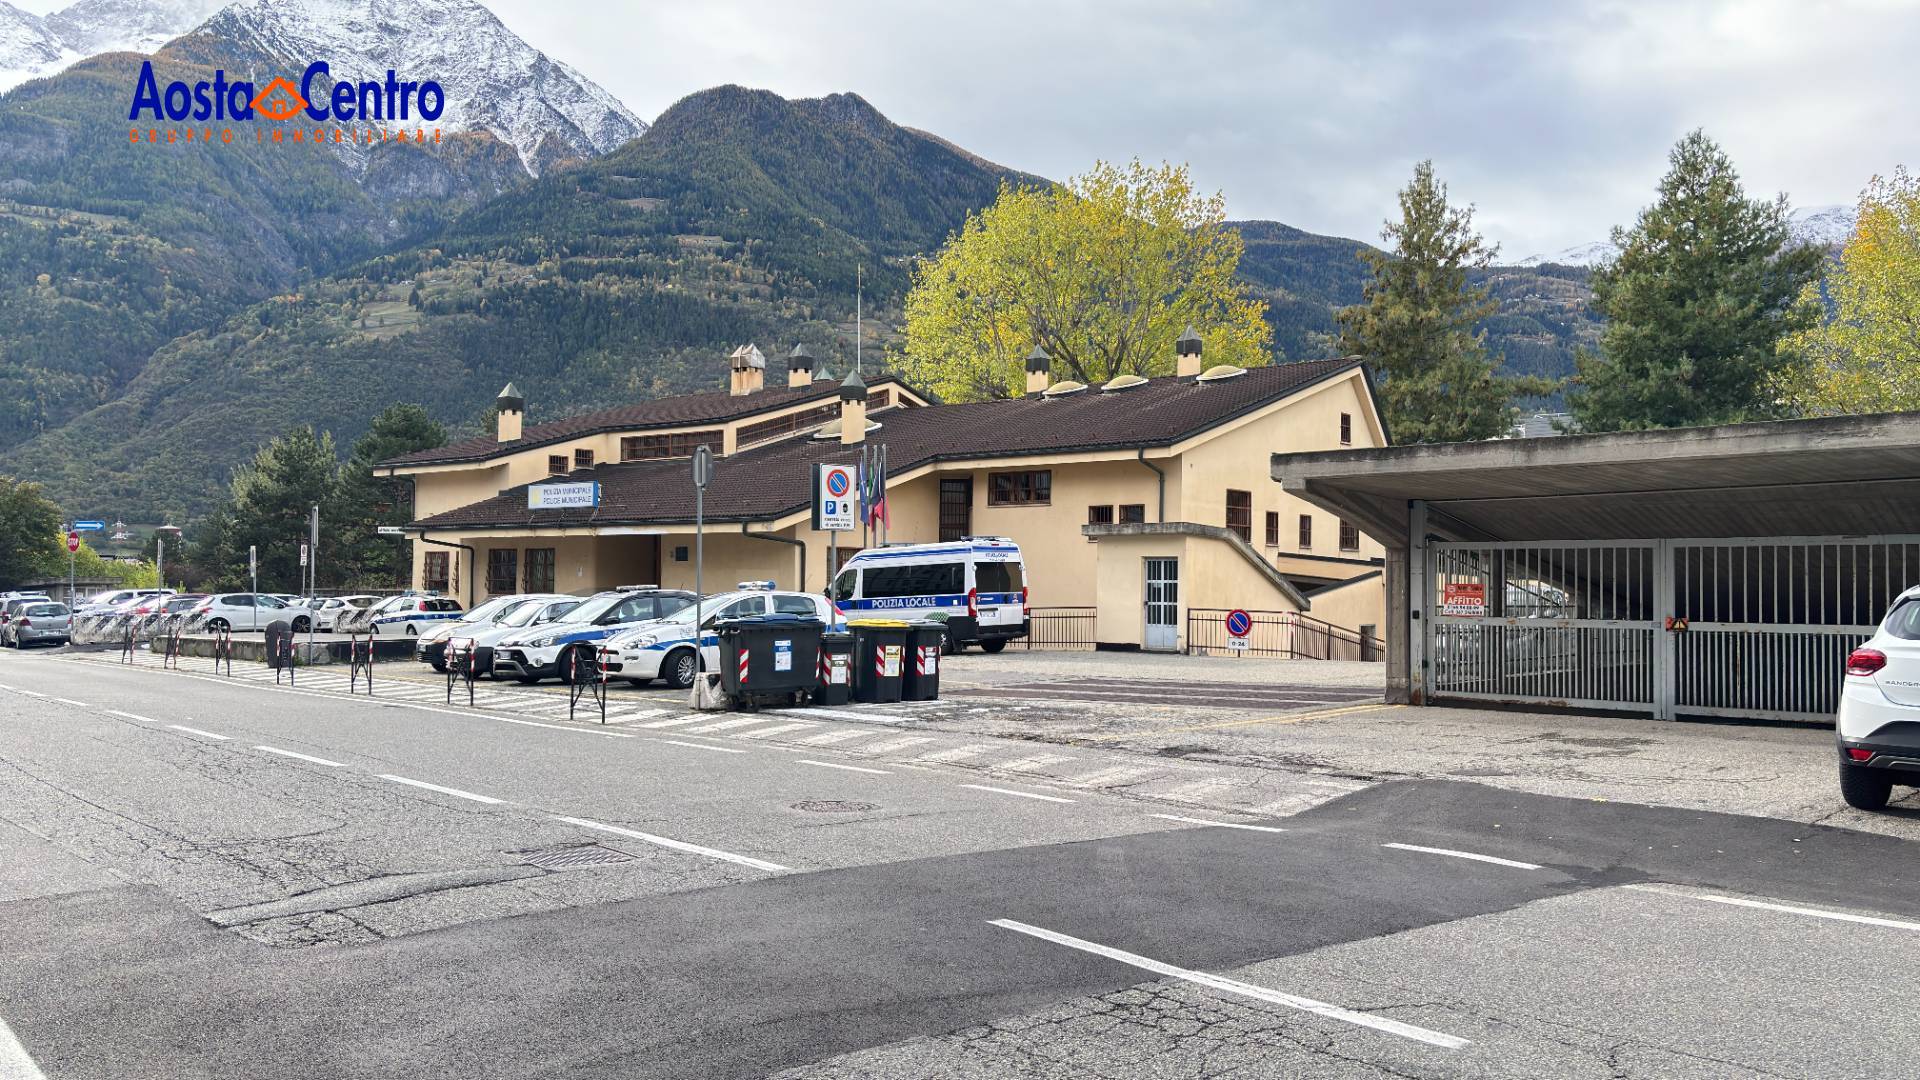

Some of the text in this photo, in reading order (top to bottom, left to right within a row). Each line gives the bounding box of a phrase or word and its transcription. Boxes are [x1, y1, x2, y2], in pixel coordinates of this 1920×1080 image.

[563, 486, 592, 495] MUNICIPALE
[562, 495, 592, 504] MUNICIPALE
[827, 502, 834, 513] P
[67, 537, 78, 546] STOP
[871, 597, 936, 609] POLIZIA LOCALE
